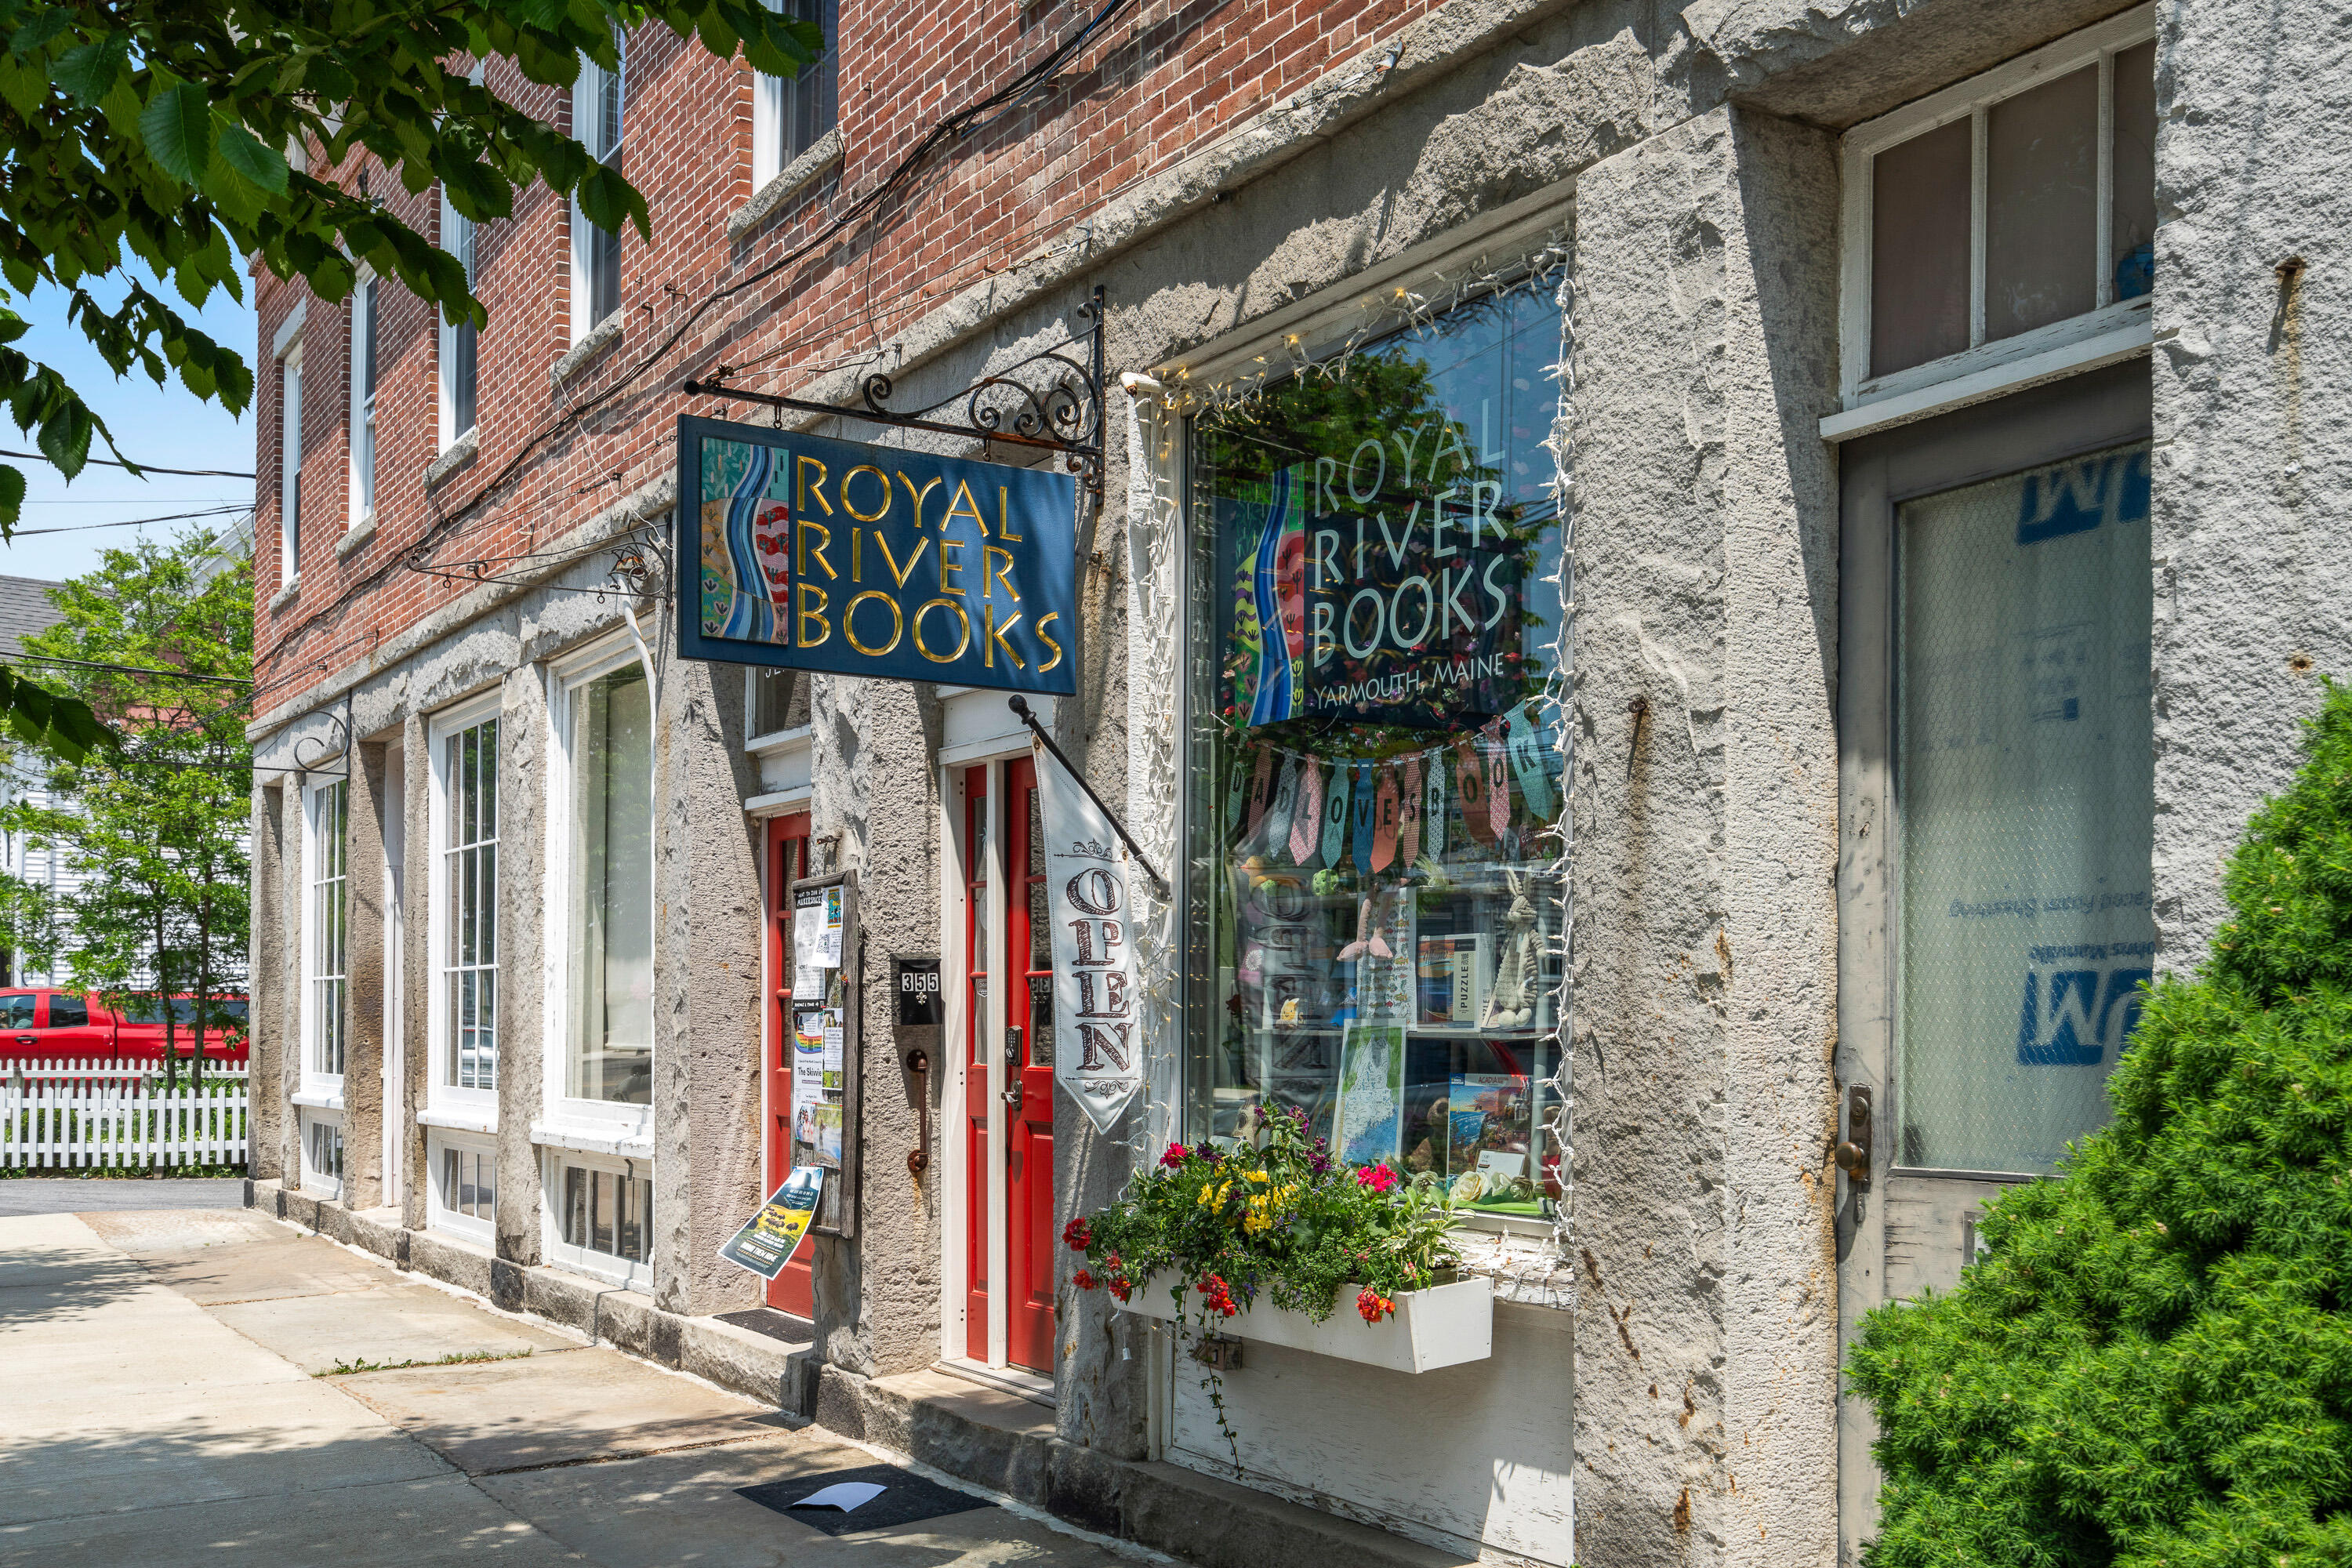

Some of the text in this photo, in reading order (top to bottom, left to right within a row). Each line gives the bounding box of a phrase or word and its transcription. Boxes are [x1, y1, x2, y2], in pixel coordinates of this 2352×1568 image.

[797, 455, 1022, 543] ROYAL
[1315, 398, 1506, 517] ROYAL
[797, 519, 1022, 603] RIVER
[1314, 481, 1508, 590] RIVER
[797, 583, 1063, 673] BOOKS
[1313, 554, 1507, 669] BOOKS
[1313, 652, 1504, 710] YARMOUTH, MAINE
[904, 974, 937, 990] 355
[1066, 867, 1134, 1072] OPEN
[1460, 967, 1468, 1008] PUZZLE
[807, 1067, 822, 1077] Skivvie
[1478, 1076, 1498, 1084] ACADIA
